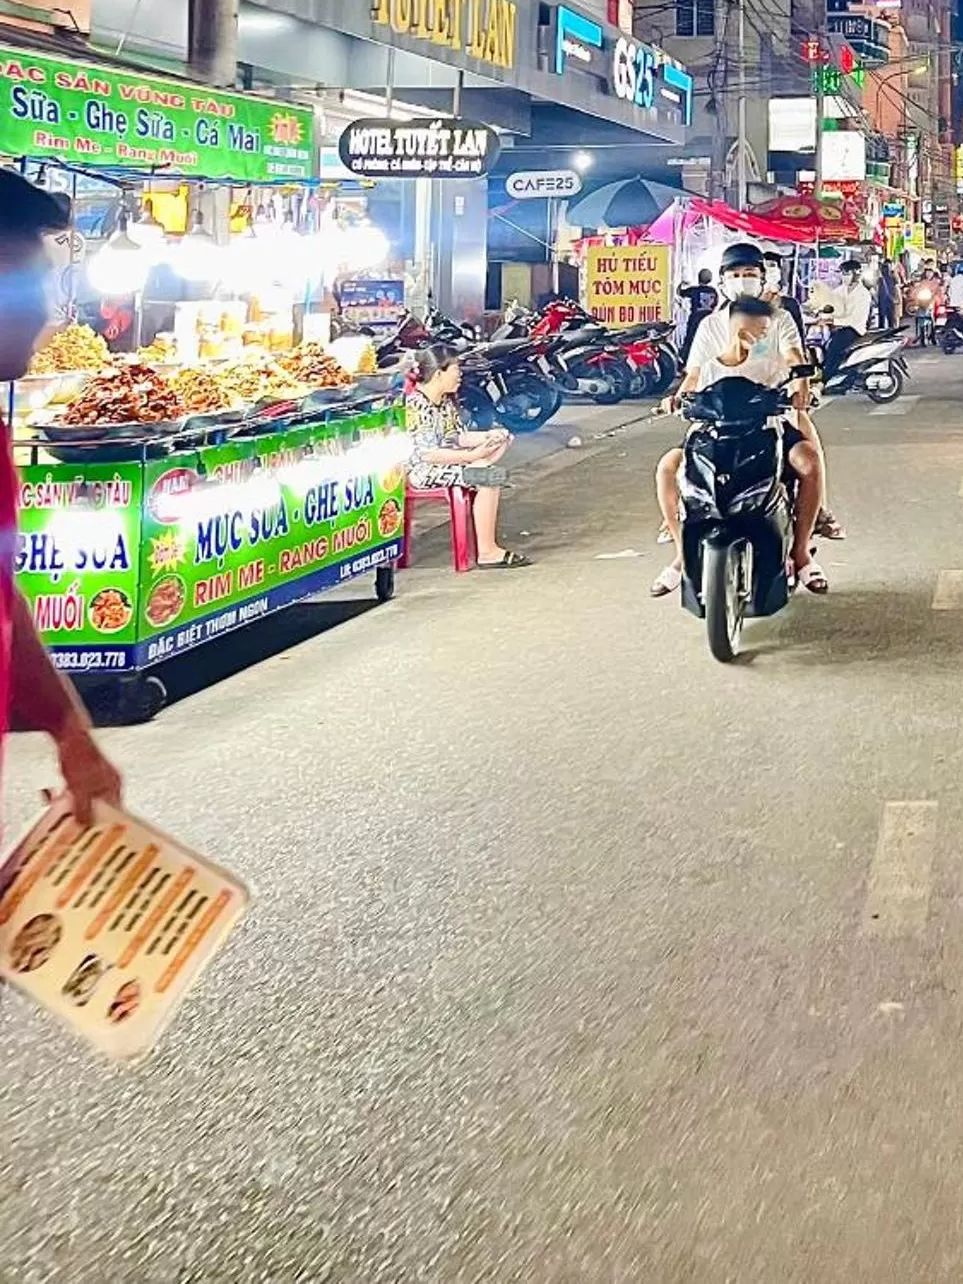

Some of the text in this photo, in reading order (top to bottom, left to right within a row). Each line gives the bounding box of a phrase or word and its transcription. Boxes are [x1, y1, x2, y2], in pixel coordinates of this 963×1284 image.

[0, 61, 45, 83] ẶC
[613, 36, 655, 109] GS25
[86, 100, 127, 140] Ghẹ
[196, 118, 220, 147] Cá
[227, 123, 261, 153] Mai
[349, 119, 488, 156] HOTEL TUYẾT LAN
[512, 177, 575, 191] CAFE25
[194, 571, 233, 607] RIM
[238, 559, 265, 591] ME
[279, 536, 329, 573] RANG
[35, 582, 85, 631] MUỐI
